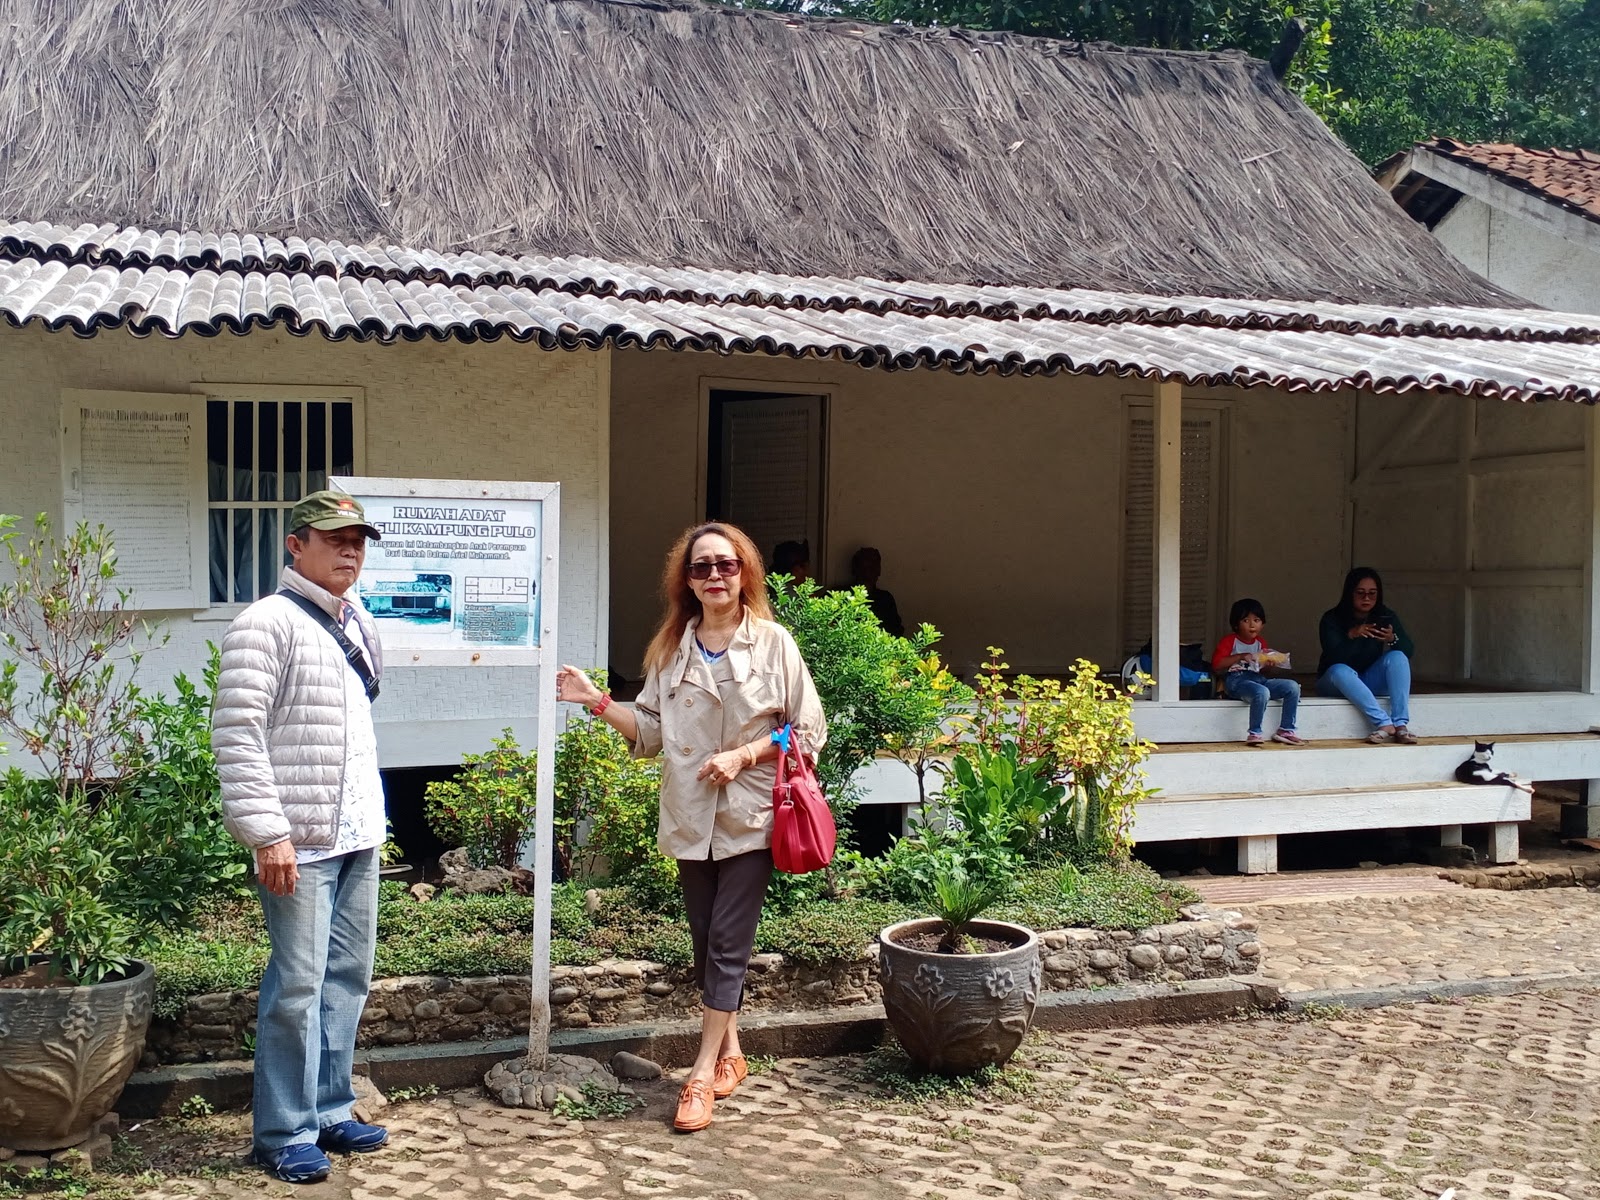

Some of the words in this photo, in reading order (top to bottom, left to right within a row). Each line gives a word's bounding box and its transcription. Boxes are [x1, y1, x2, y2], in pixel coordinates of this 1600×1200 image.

[394, 507, 457, 520] RUMAH
[458, 509, 506, 522] ADAT
[366, 522, 400, 534] SLI
[402, 523, 489, 537] KAMPUNG
[491, 525, 536, 539] PULO
[369, 540, 404, 549] Bangunan
[416, 540, 468, 551] Melambangkan
[470, 542, 487, 551] Anak
[488, 543, 526, 552] Perempuan
[385, 549, 400, 557] Dari
[402, 549, 426, 558] Embah
[427, 550, 449, 559] Dalem
